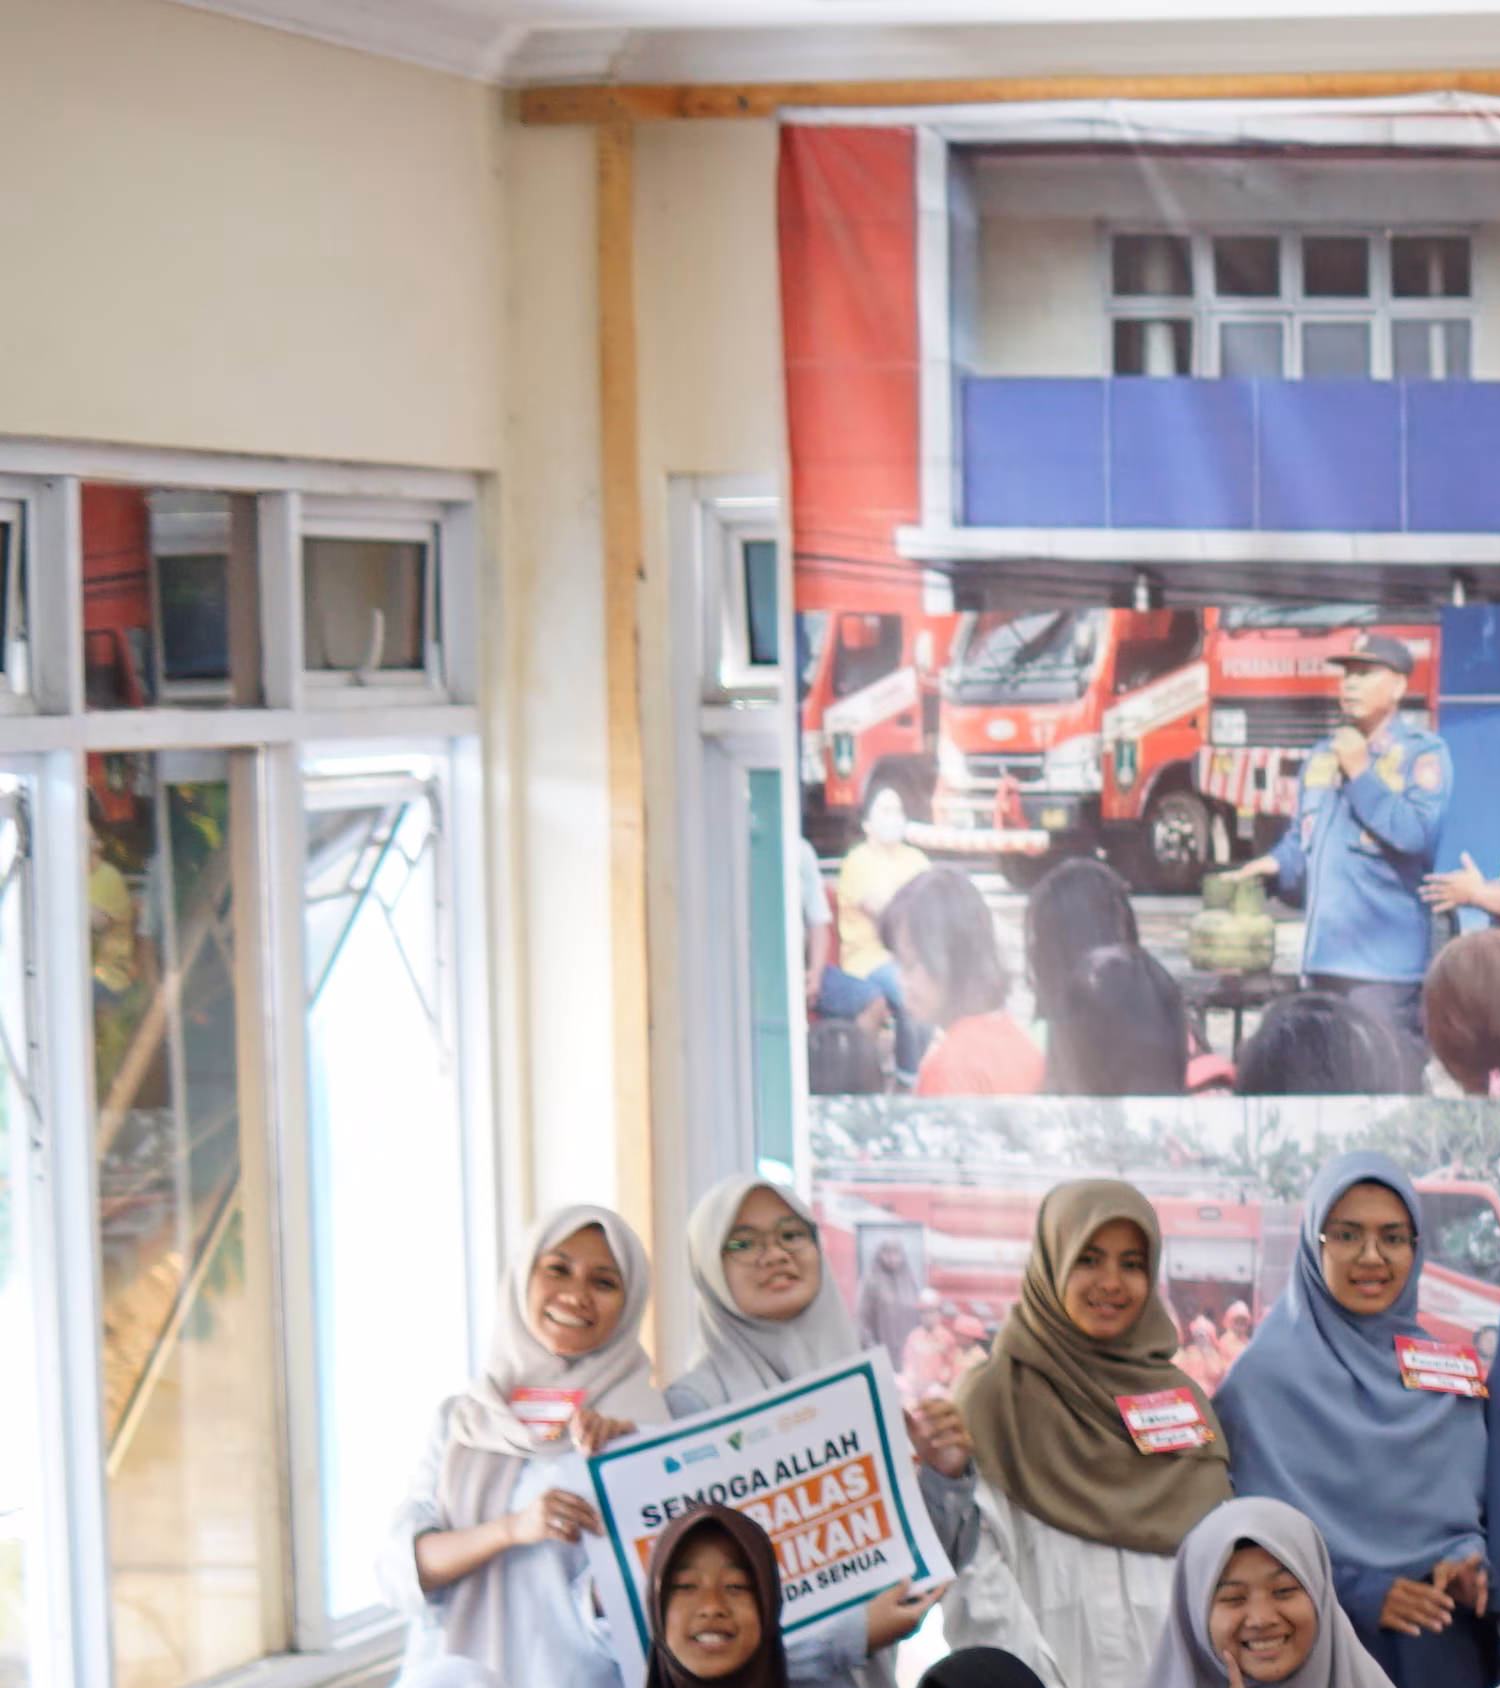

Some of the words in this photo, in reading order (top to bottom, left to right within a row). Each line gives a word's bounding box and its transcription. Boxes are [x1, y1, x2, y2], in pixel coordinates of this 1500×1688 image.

[641, 1469, 770, 1529] SEMOGA
[774, 1430, 862, 1481] ALLAH
[815, 1548, 889, 1590] SEMUA
